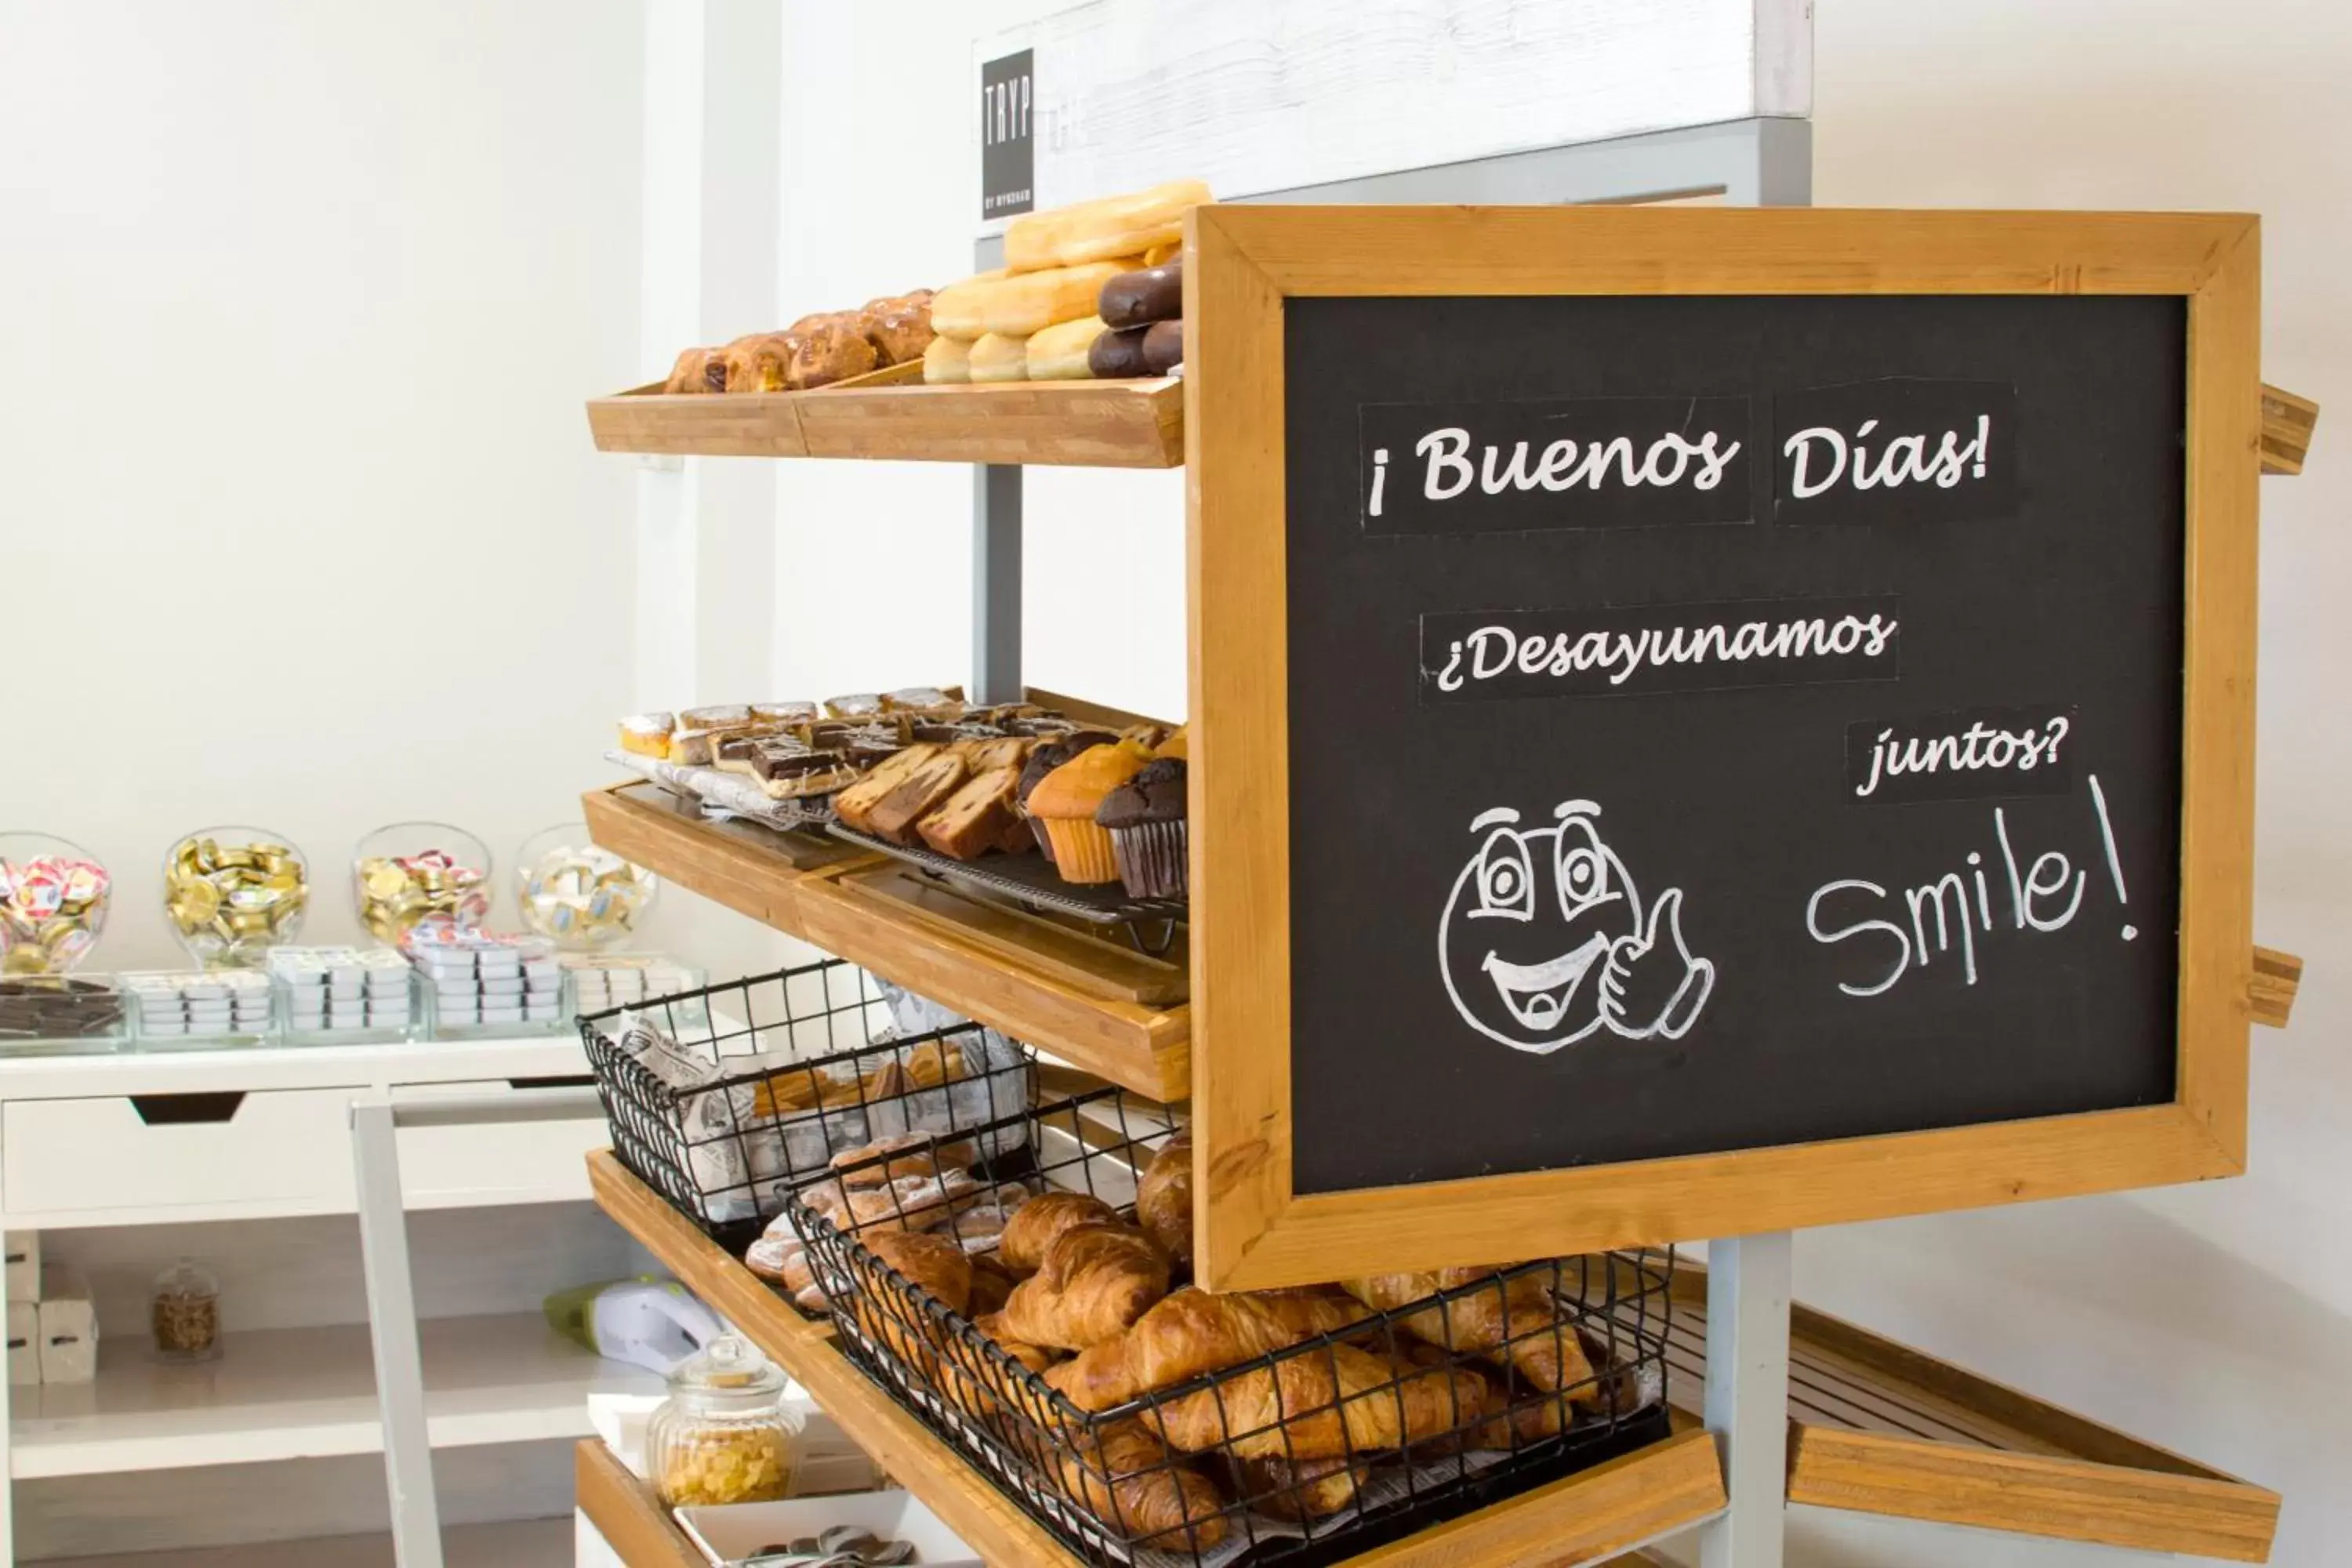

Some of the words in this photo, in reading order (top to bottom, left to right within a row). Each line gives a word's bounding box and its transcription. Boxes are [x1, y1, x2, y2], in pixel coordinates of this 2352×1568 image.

[985, 75, 1029, 146] TRYP
[1784, 415, 1990, 499] Días!
[1438, 614, 1897, 691] ¿Desayunamos
[1856, 717, 2069, 796] juntos?
[1807, 774, 2137, 996] Smile!
